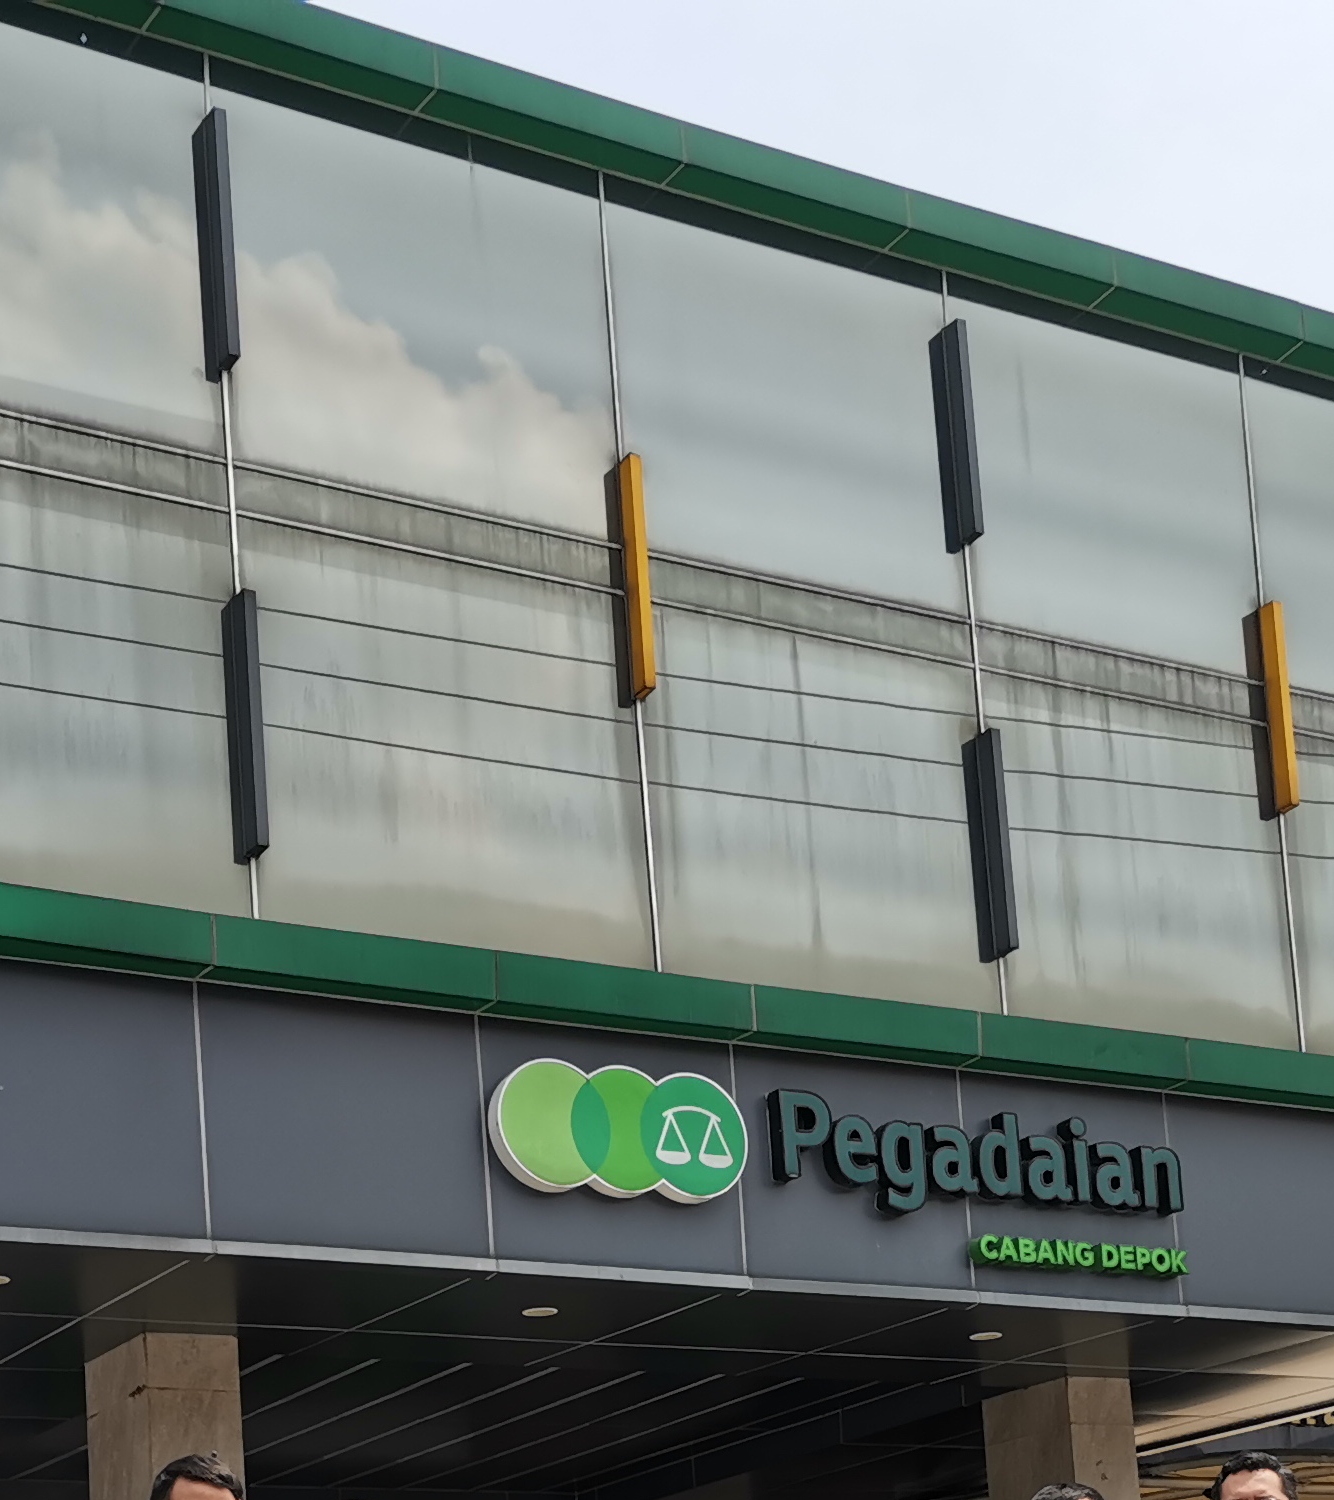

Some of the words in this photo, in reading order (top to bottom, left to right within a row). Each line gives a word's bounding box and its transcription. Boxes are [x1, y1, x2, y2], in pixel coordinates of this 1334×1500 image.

[768, 1089, 1185, 1217] Pegadaian
[972, 1234, 1095, 1268] CABANG
[1101, 1243, 1189, 1276] DEPOK
